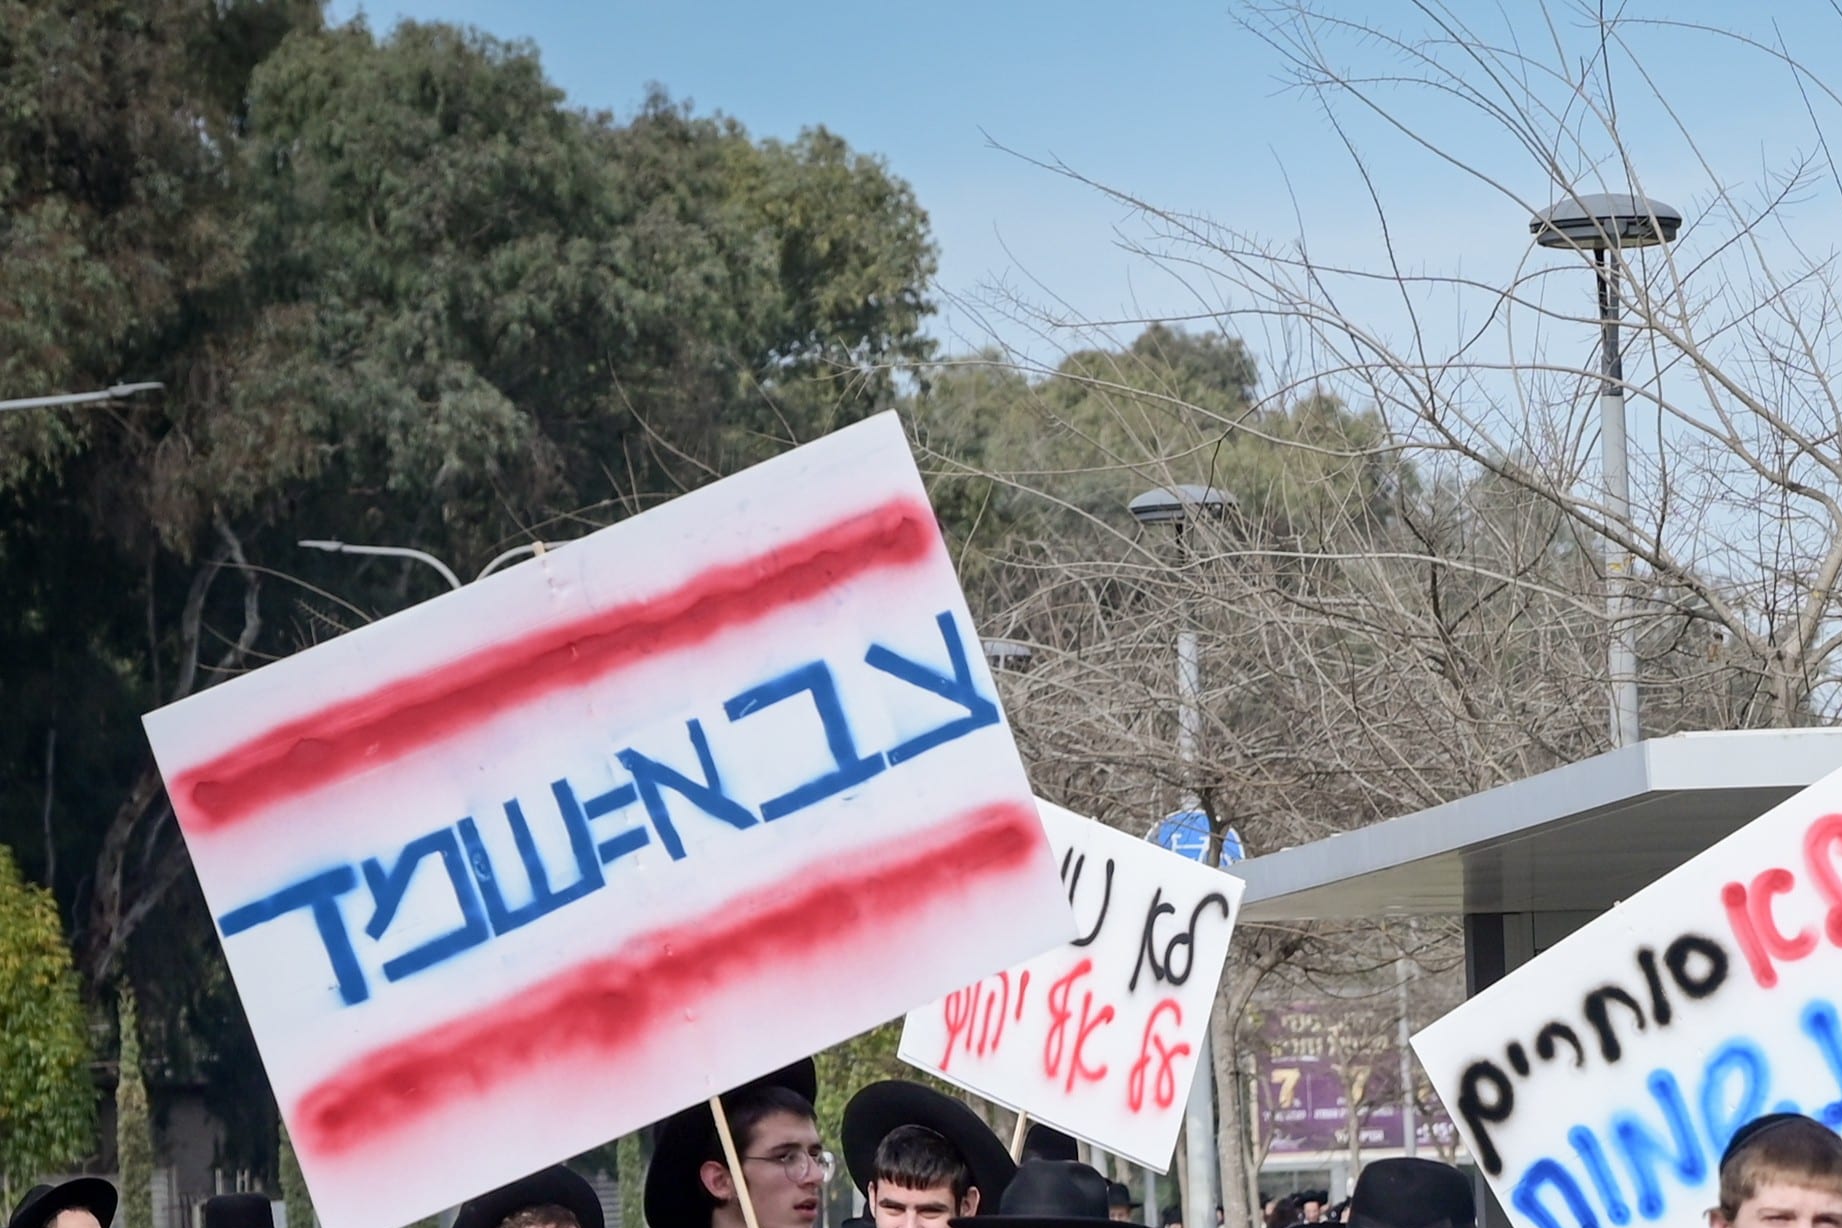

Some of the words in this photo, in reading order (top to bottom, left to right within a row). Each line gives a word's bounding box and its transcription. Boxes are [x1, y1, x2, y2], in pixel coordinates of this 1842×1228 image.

[1129, 886, 1229, 993] לא
[1044, 956, 1115, 1093] אף
[1128, 998, 1191, 1113] על
